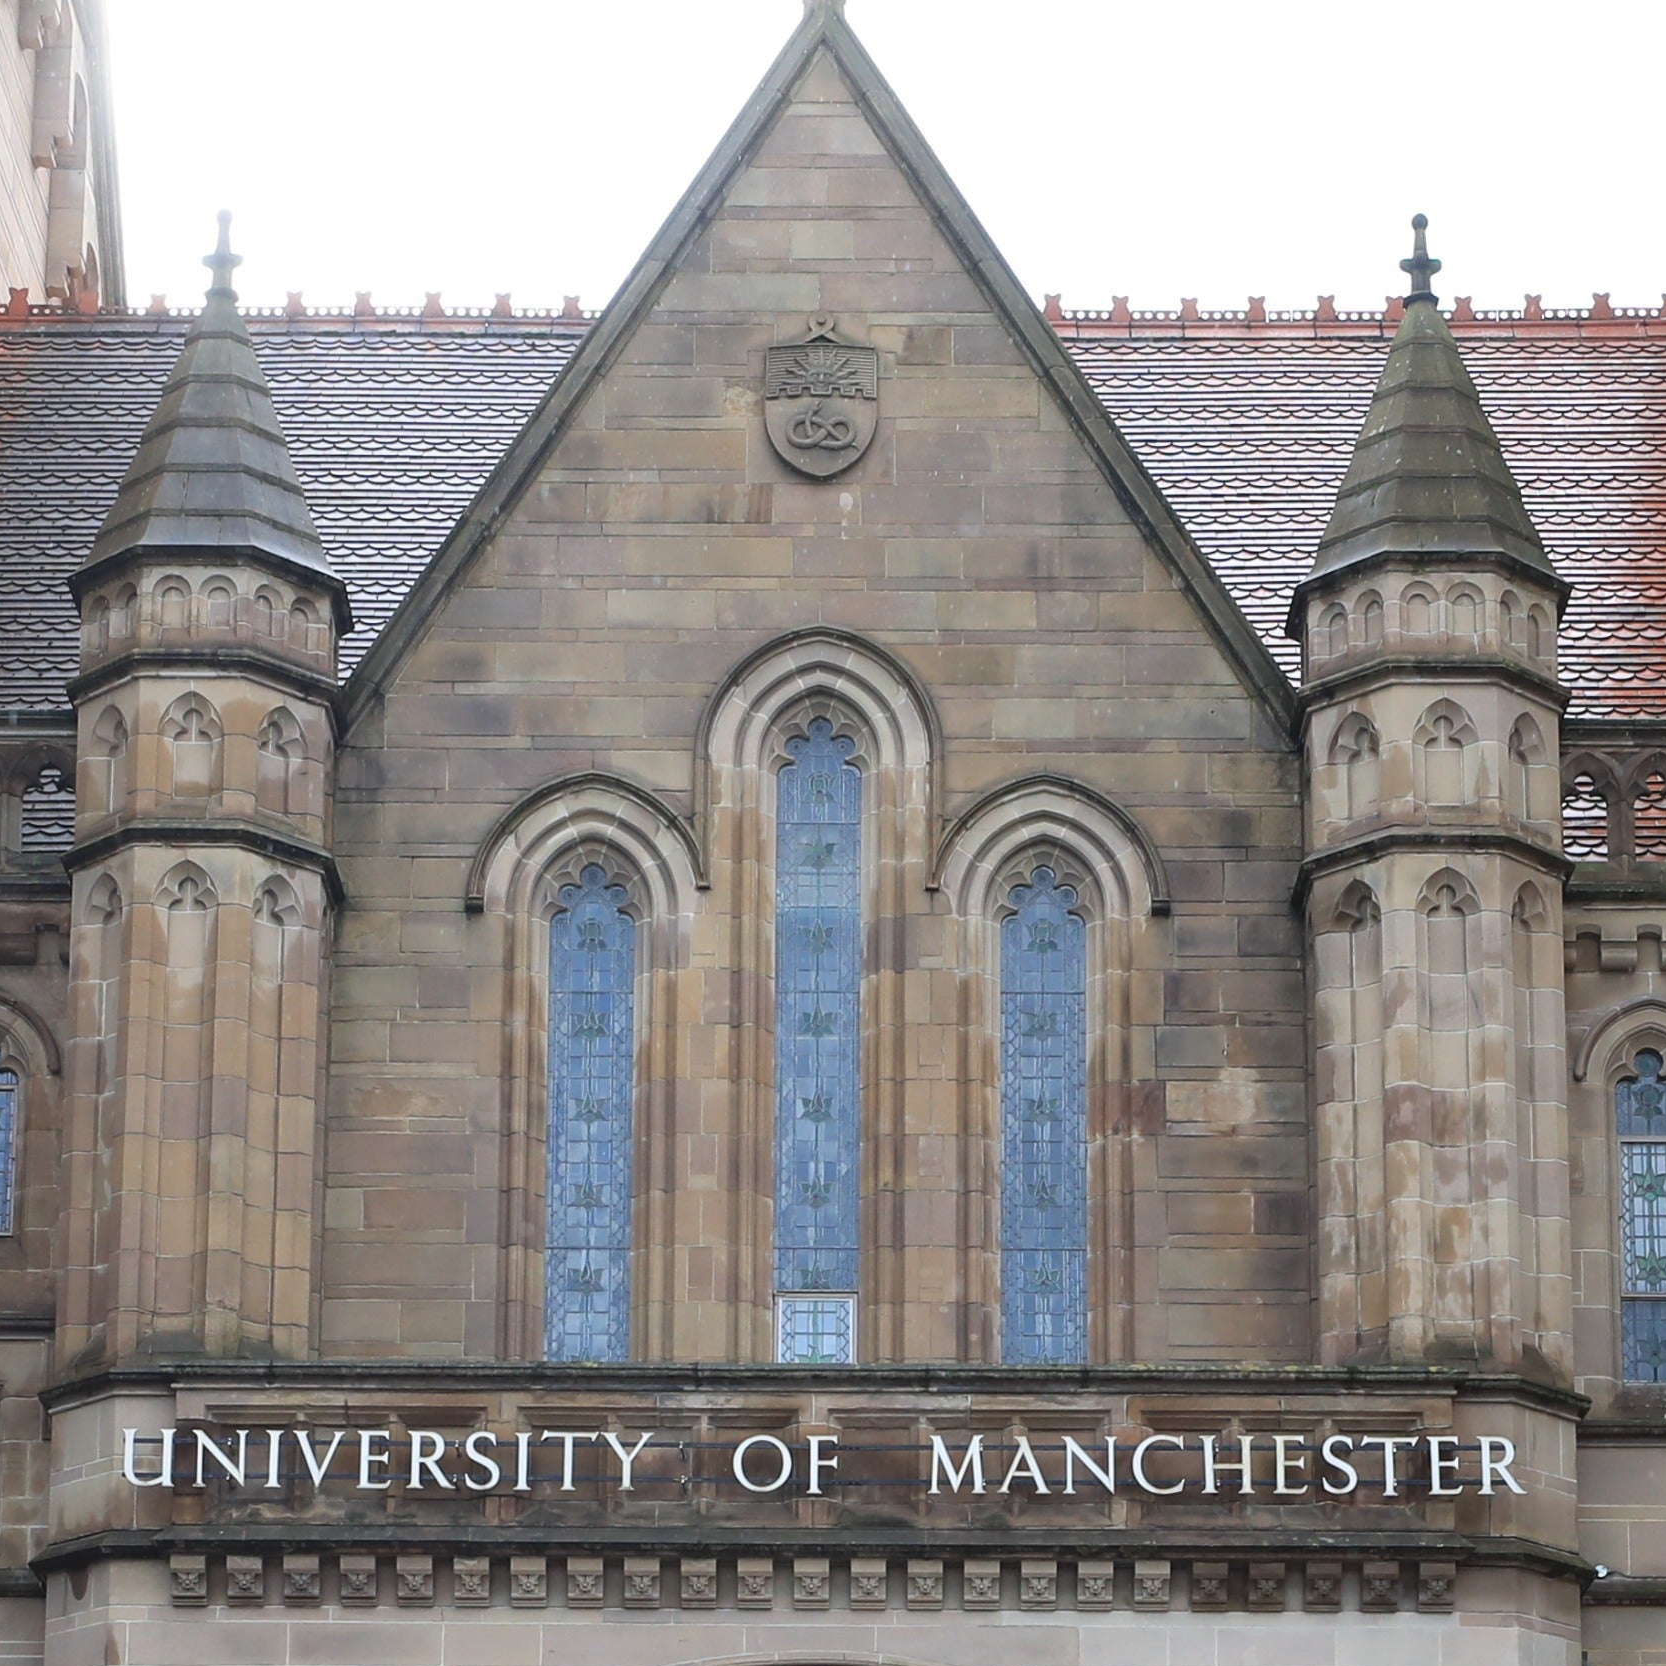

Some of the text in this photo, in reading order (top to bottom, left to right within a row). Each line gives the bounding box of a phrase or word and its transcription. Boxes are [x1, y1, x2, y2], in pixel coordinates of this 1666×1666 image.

[122, 1427, 1528, 1496] UNIVERSITY OF MANCHESTER
